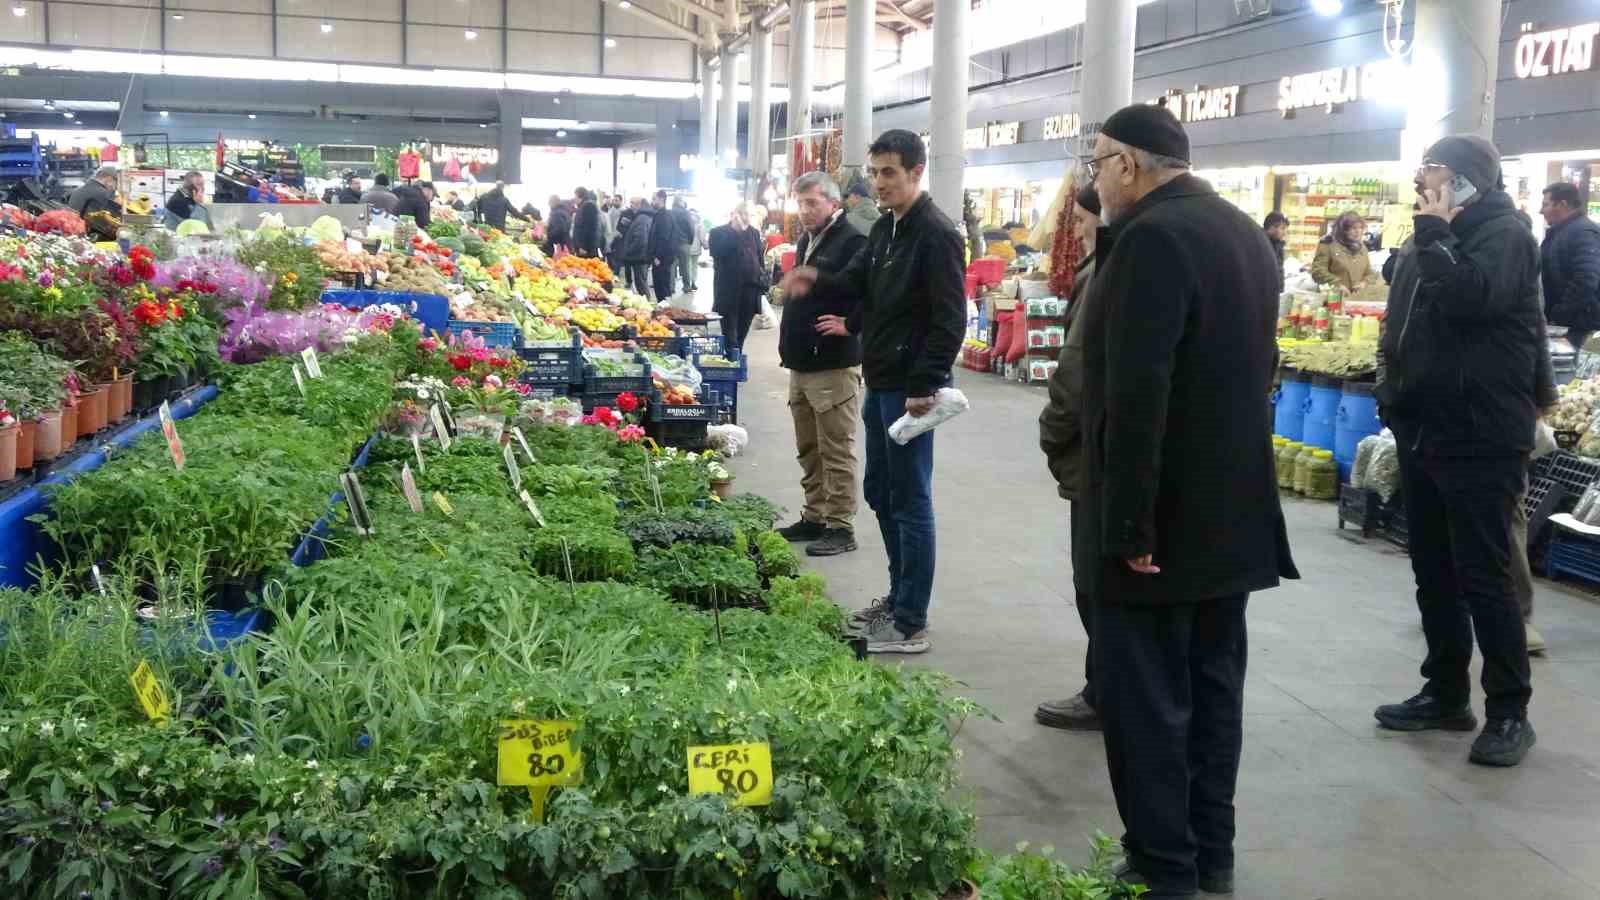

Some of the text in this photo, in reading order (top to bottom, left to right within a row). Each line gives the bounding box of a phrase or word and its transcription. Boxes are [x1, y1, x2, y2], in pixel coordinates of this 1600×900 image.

[1185, 83, 1240, 122] TİCARET
[527, 752, 565, 778] 80
[716, 768, 759, 794] 80
